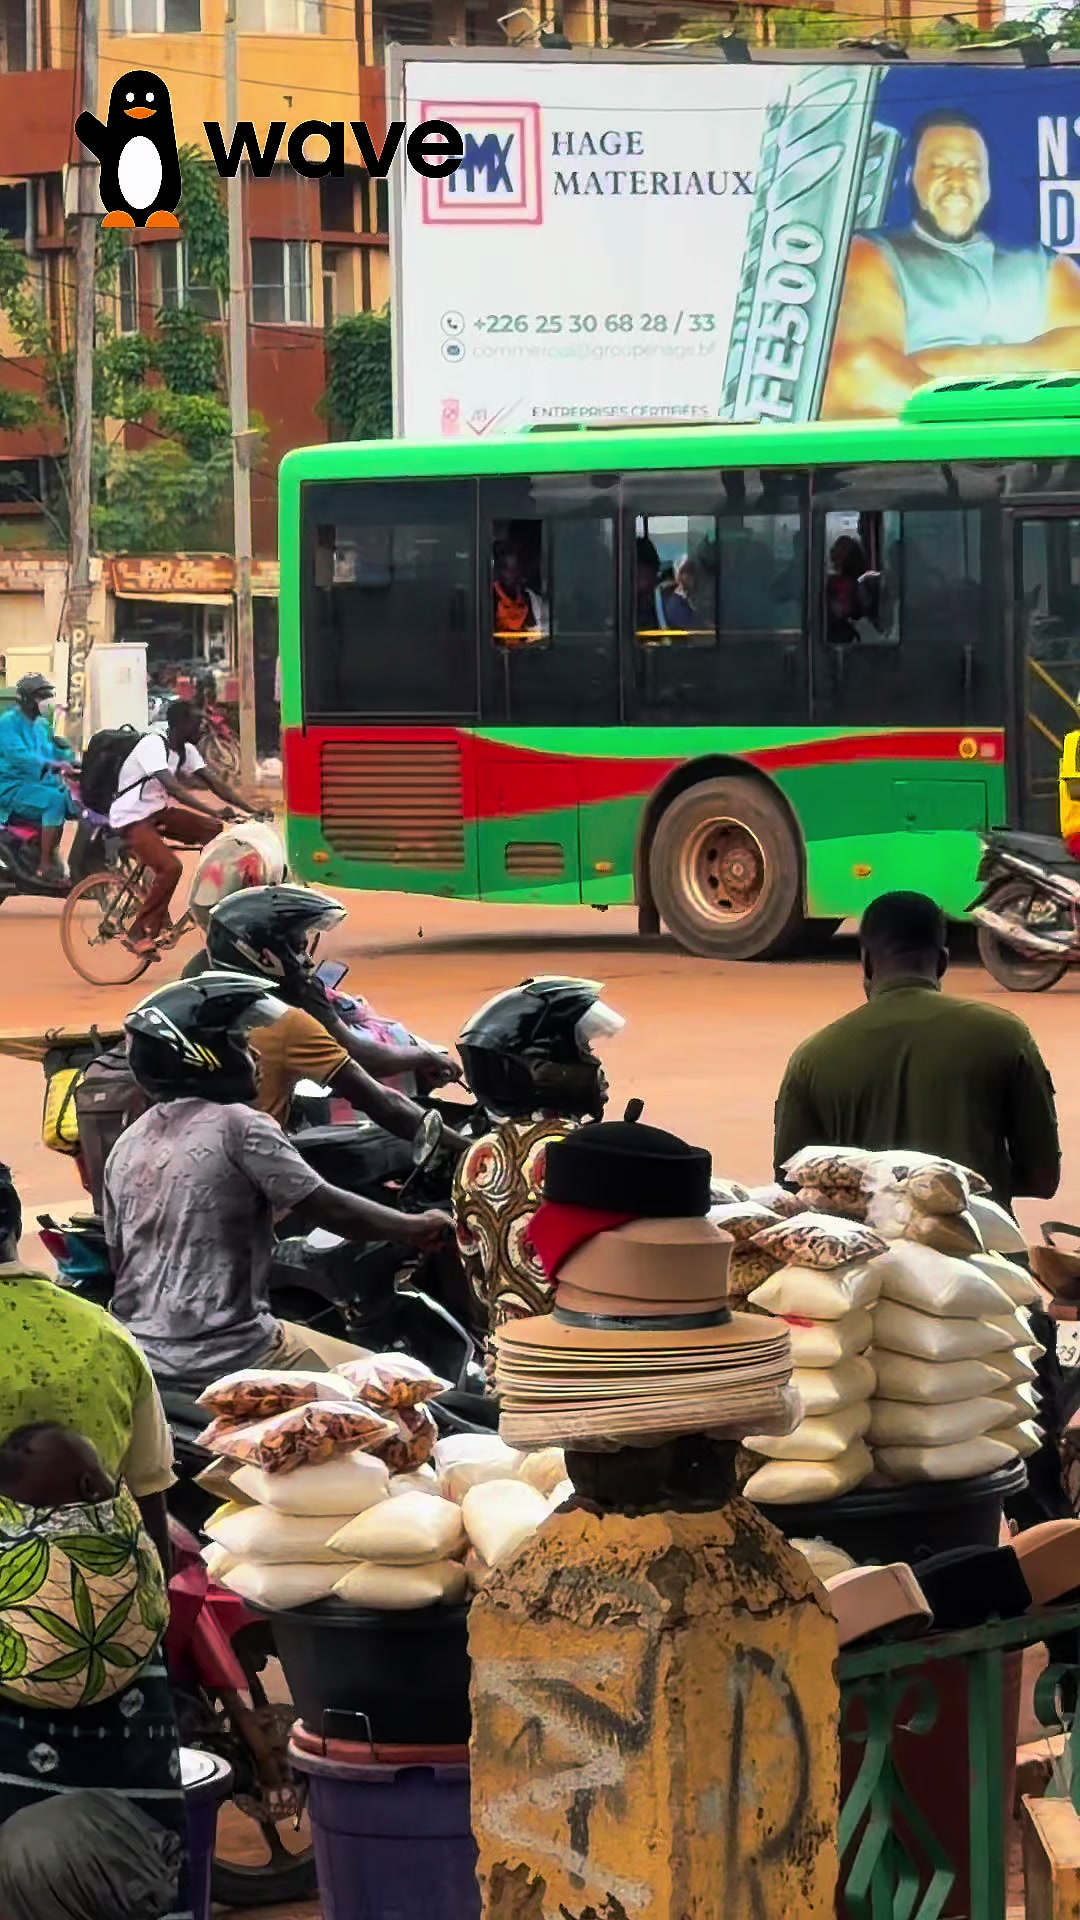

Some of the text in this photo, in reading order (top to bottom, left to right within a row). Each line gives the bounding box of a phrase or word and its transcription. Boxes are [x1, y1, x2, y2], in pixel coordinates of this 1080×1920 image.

[551, 130, 645, 156] HAGE
[553, 170, 755, 196] MATERIAUX
[473, 310, 716, 335] +226 25 30 68 28 / 33
